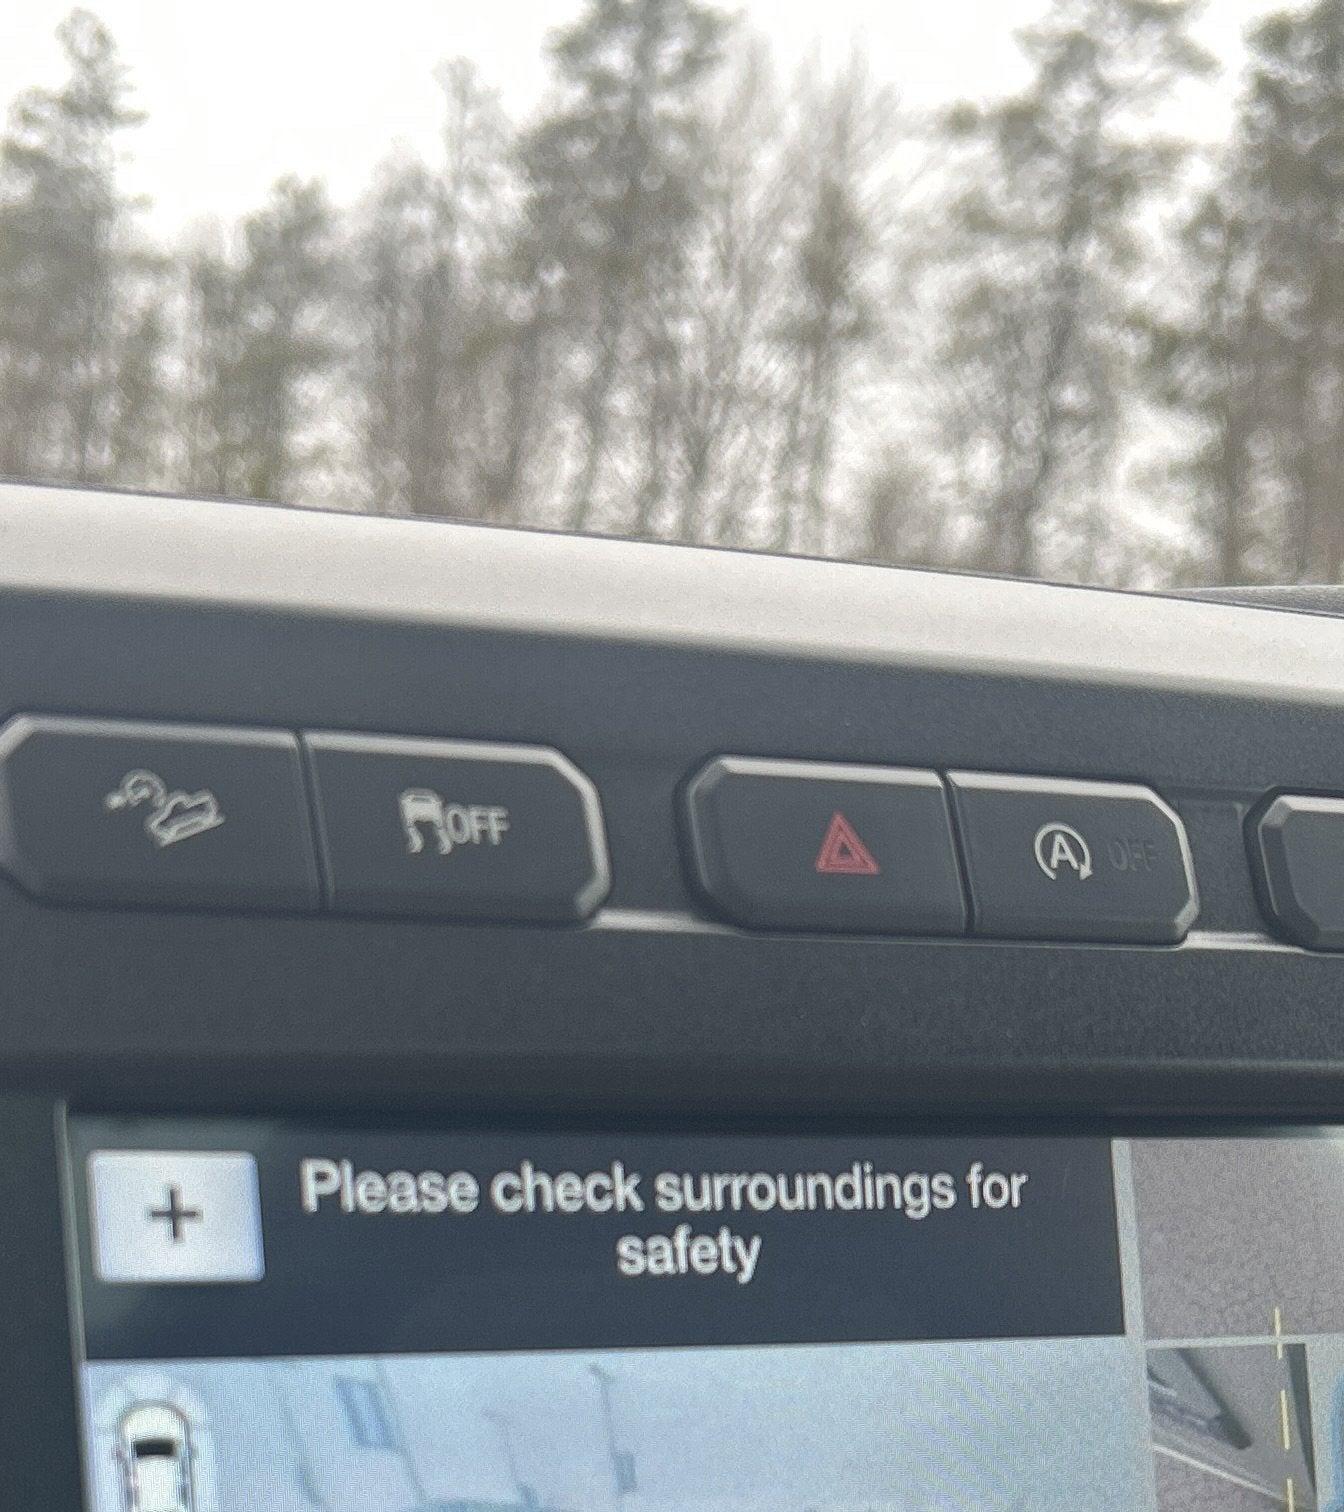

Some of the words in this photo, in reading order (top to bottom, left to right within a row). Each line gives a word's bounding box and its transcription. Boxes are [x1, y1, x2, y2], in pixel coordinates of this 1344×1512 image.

[447, 806, 510, 846] OFF
[300, 1159, 480, 1213] Please
[489, 1160, 645, 1212] check
[654, 1163, 958, 1219] surroundings
[965, 1163, 1029, 1210] for
[616, 1225, 762, 1284] safety
